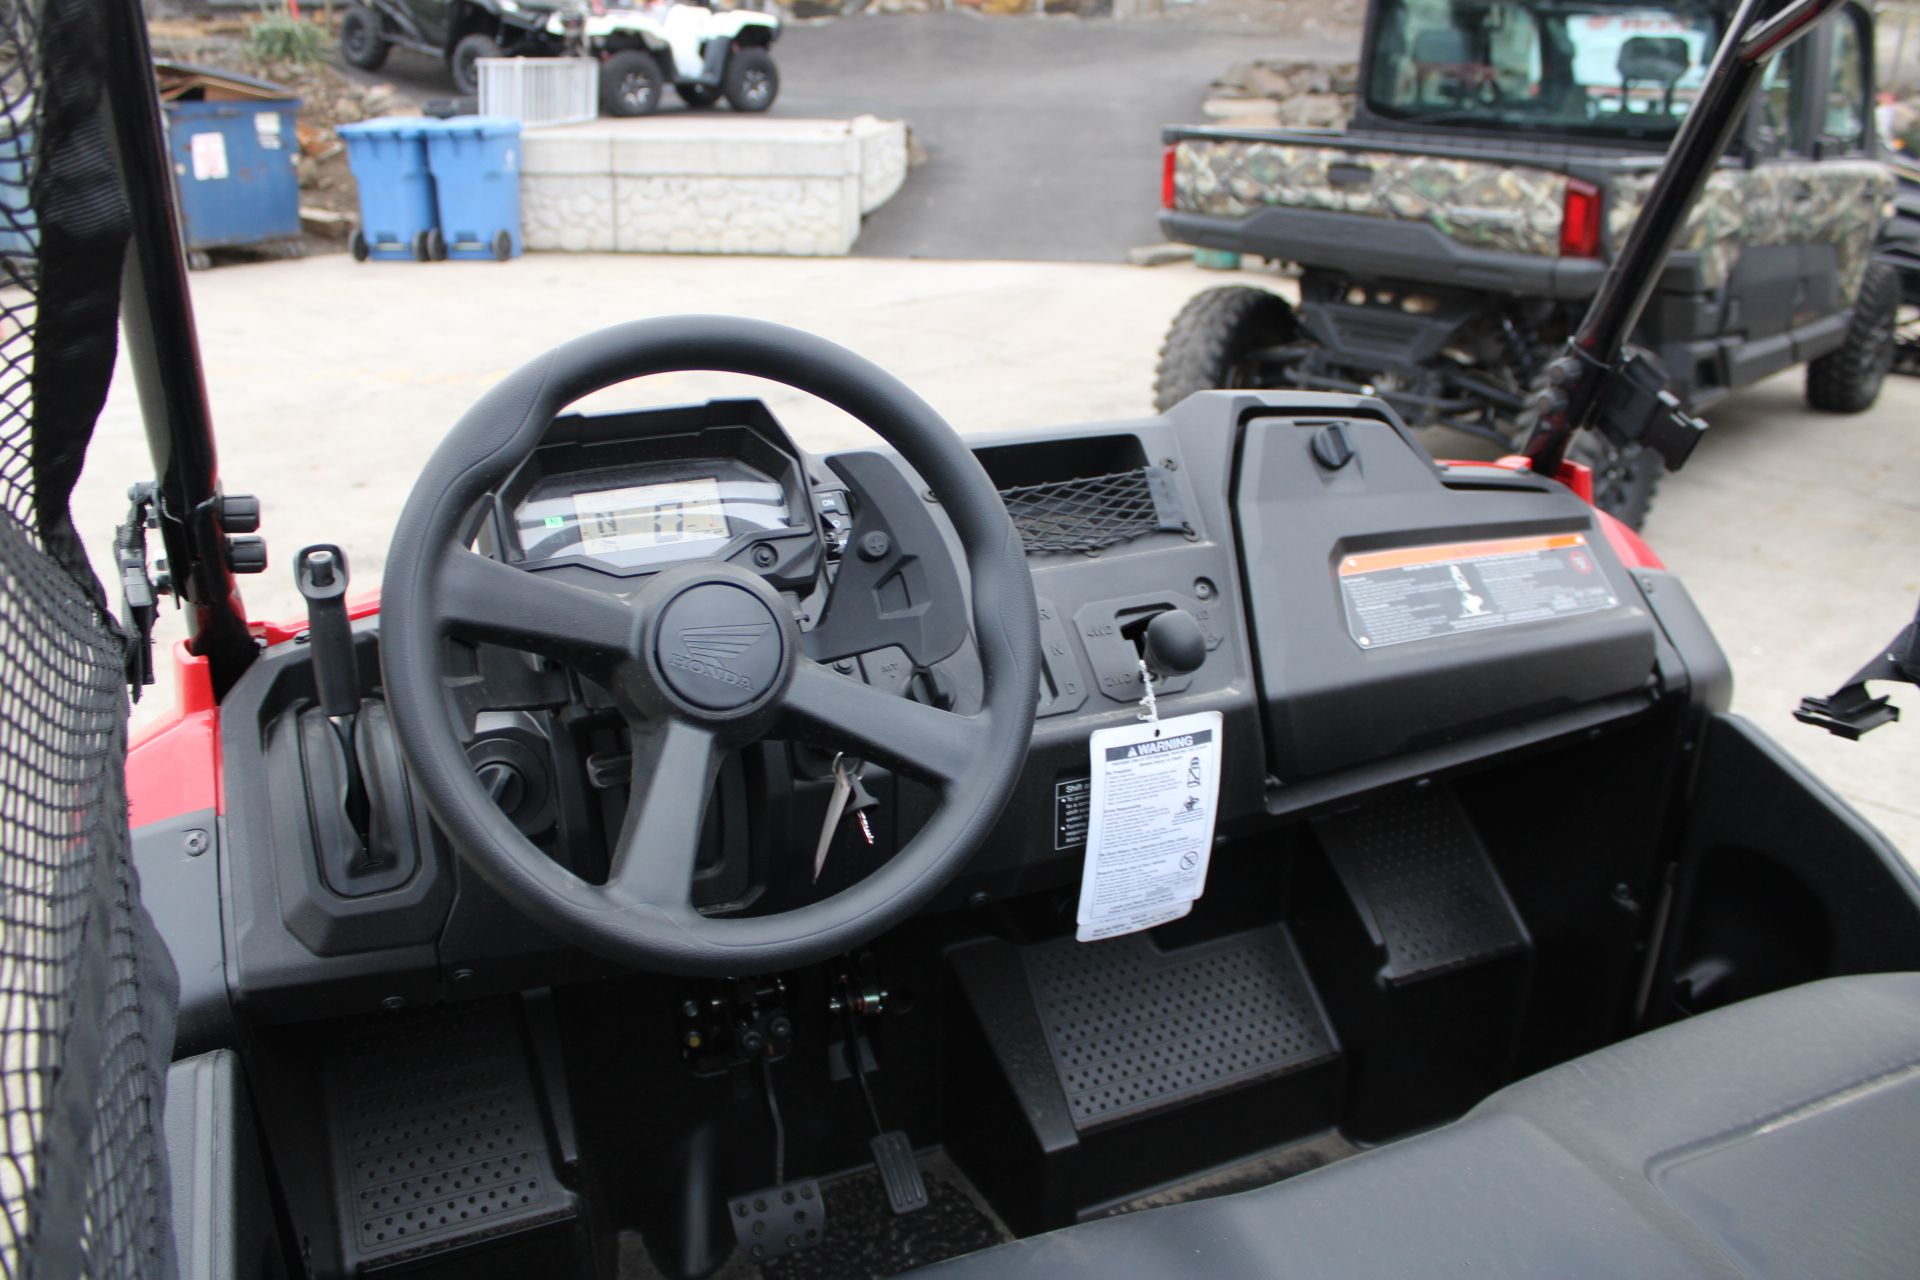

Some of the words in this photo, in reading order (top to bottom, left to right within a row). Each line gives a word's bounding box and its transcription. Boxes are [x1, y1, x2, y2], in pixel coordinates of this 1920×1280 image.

[1086, 625, 1113, 638] 4WD
[668, 652, 754, 691] HONDA
[1137, 735, 1194, 756] WARNING
